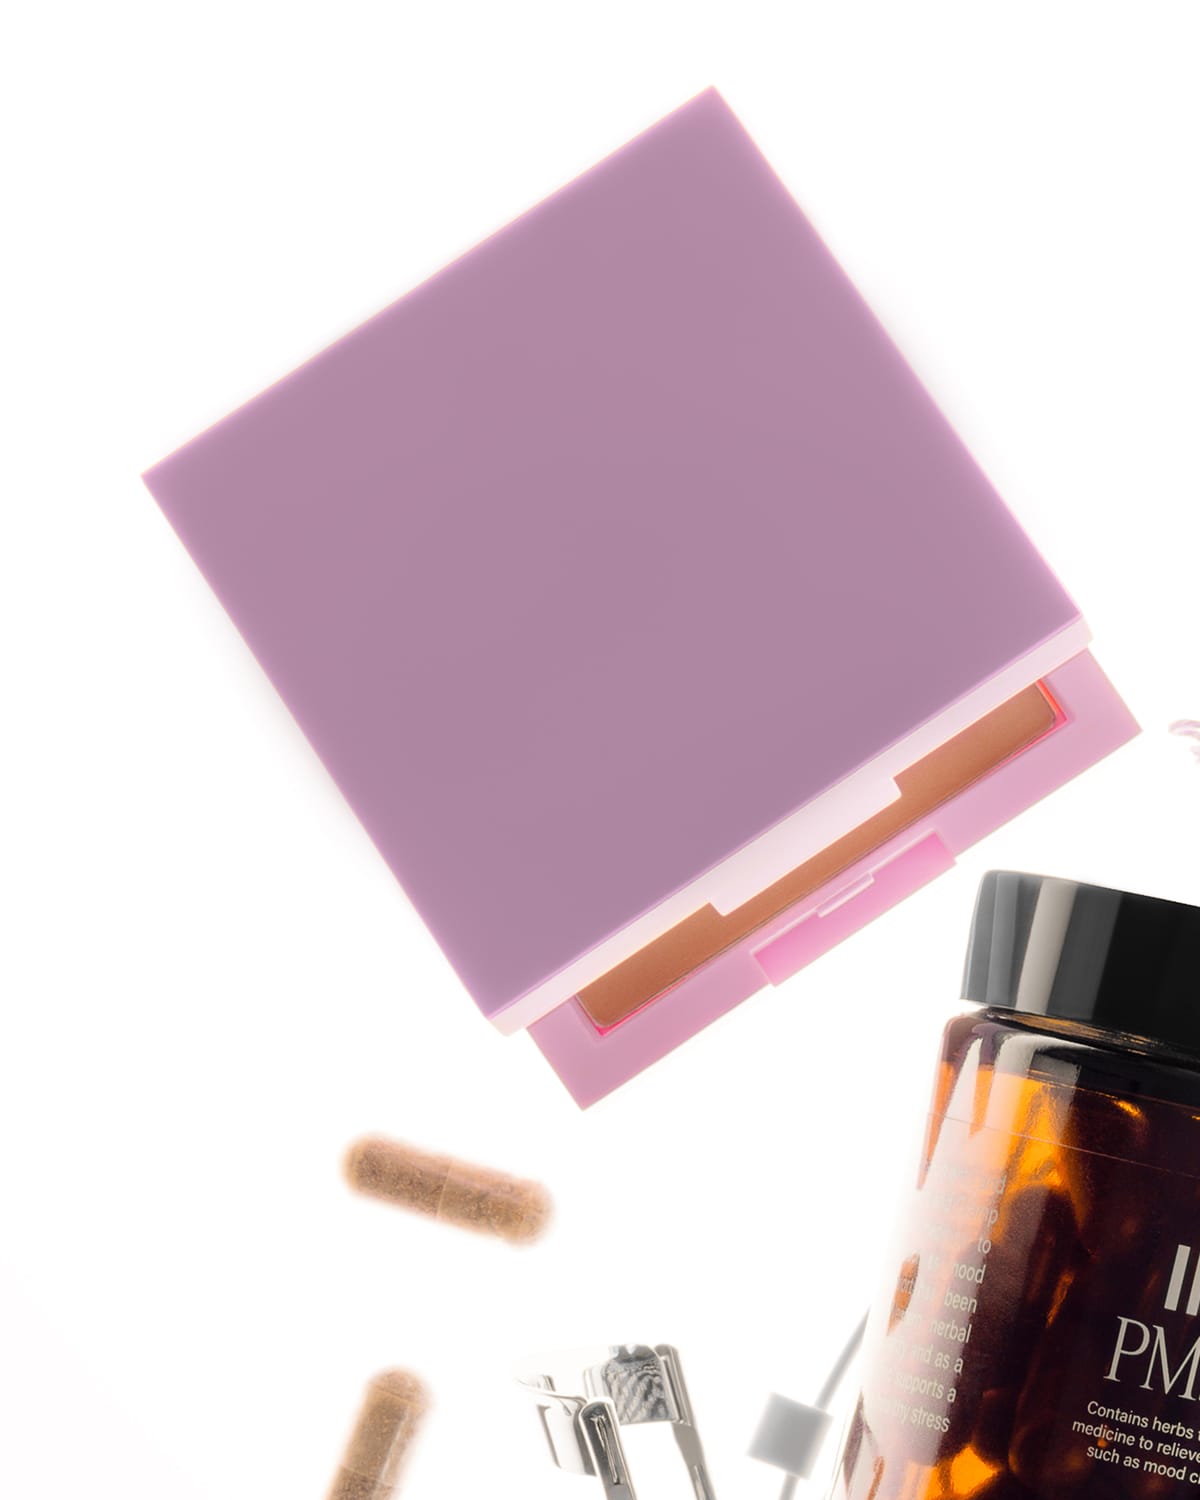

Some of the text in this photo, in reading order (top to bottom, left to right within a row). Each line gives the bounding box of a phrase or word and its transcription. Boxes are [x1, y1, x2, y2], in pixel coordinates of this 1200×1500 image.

[943, 1286, 977, 1314] been
[934, 1352, 951, 1370] as
[953, 1355, 965, 1375] a
[947, 1385, 957, 1403] a
[911, 1406, 952, 1433] stress
[1087, 1400, 1149, 1428] Contains
[1152, 1416, 1194, 1439] herbs
[1072, 1420, 1136, 1446] medicine
[1139, 1435, 1154, 1451] to
[1086, 1446, 1120, 1464] such
[1123, 1456, 1140, 1469] as
[1143, 1460, 1187, 1481] mood
